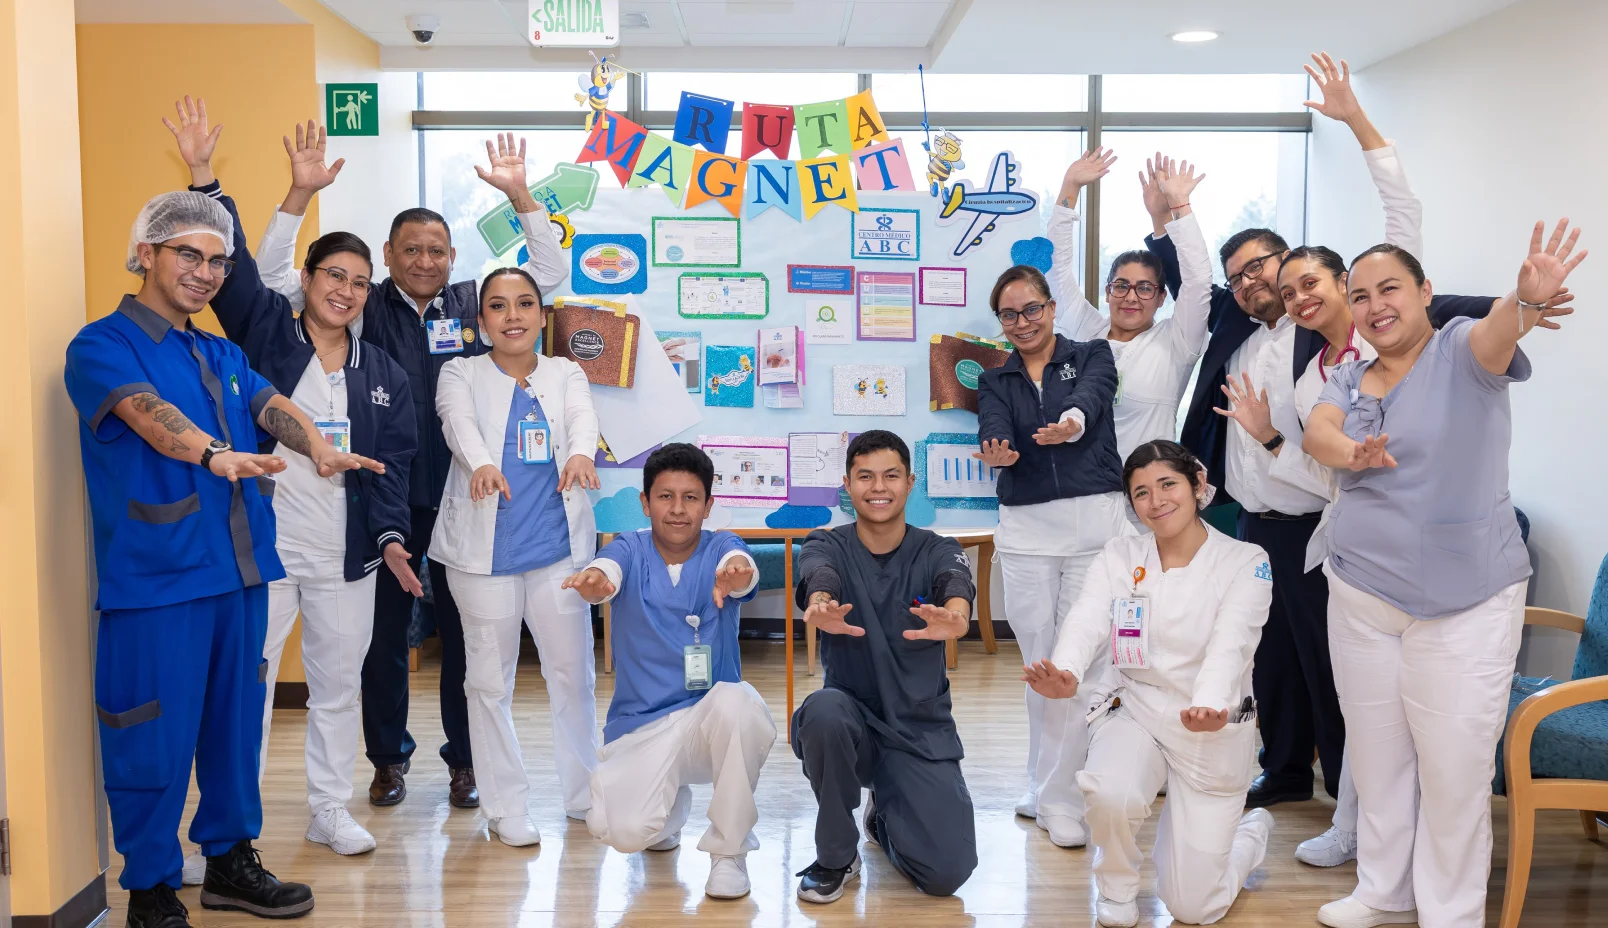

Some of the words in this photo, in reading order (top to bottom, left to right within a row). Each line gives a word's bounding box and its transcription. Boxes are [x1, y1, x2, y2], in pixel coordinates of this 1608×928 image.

[543, 0, 604, 33] SALIDA
[585, 114, 901, 205] MAGNET
[574, 334, 600, 342] MAGNET
